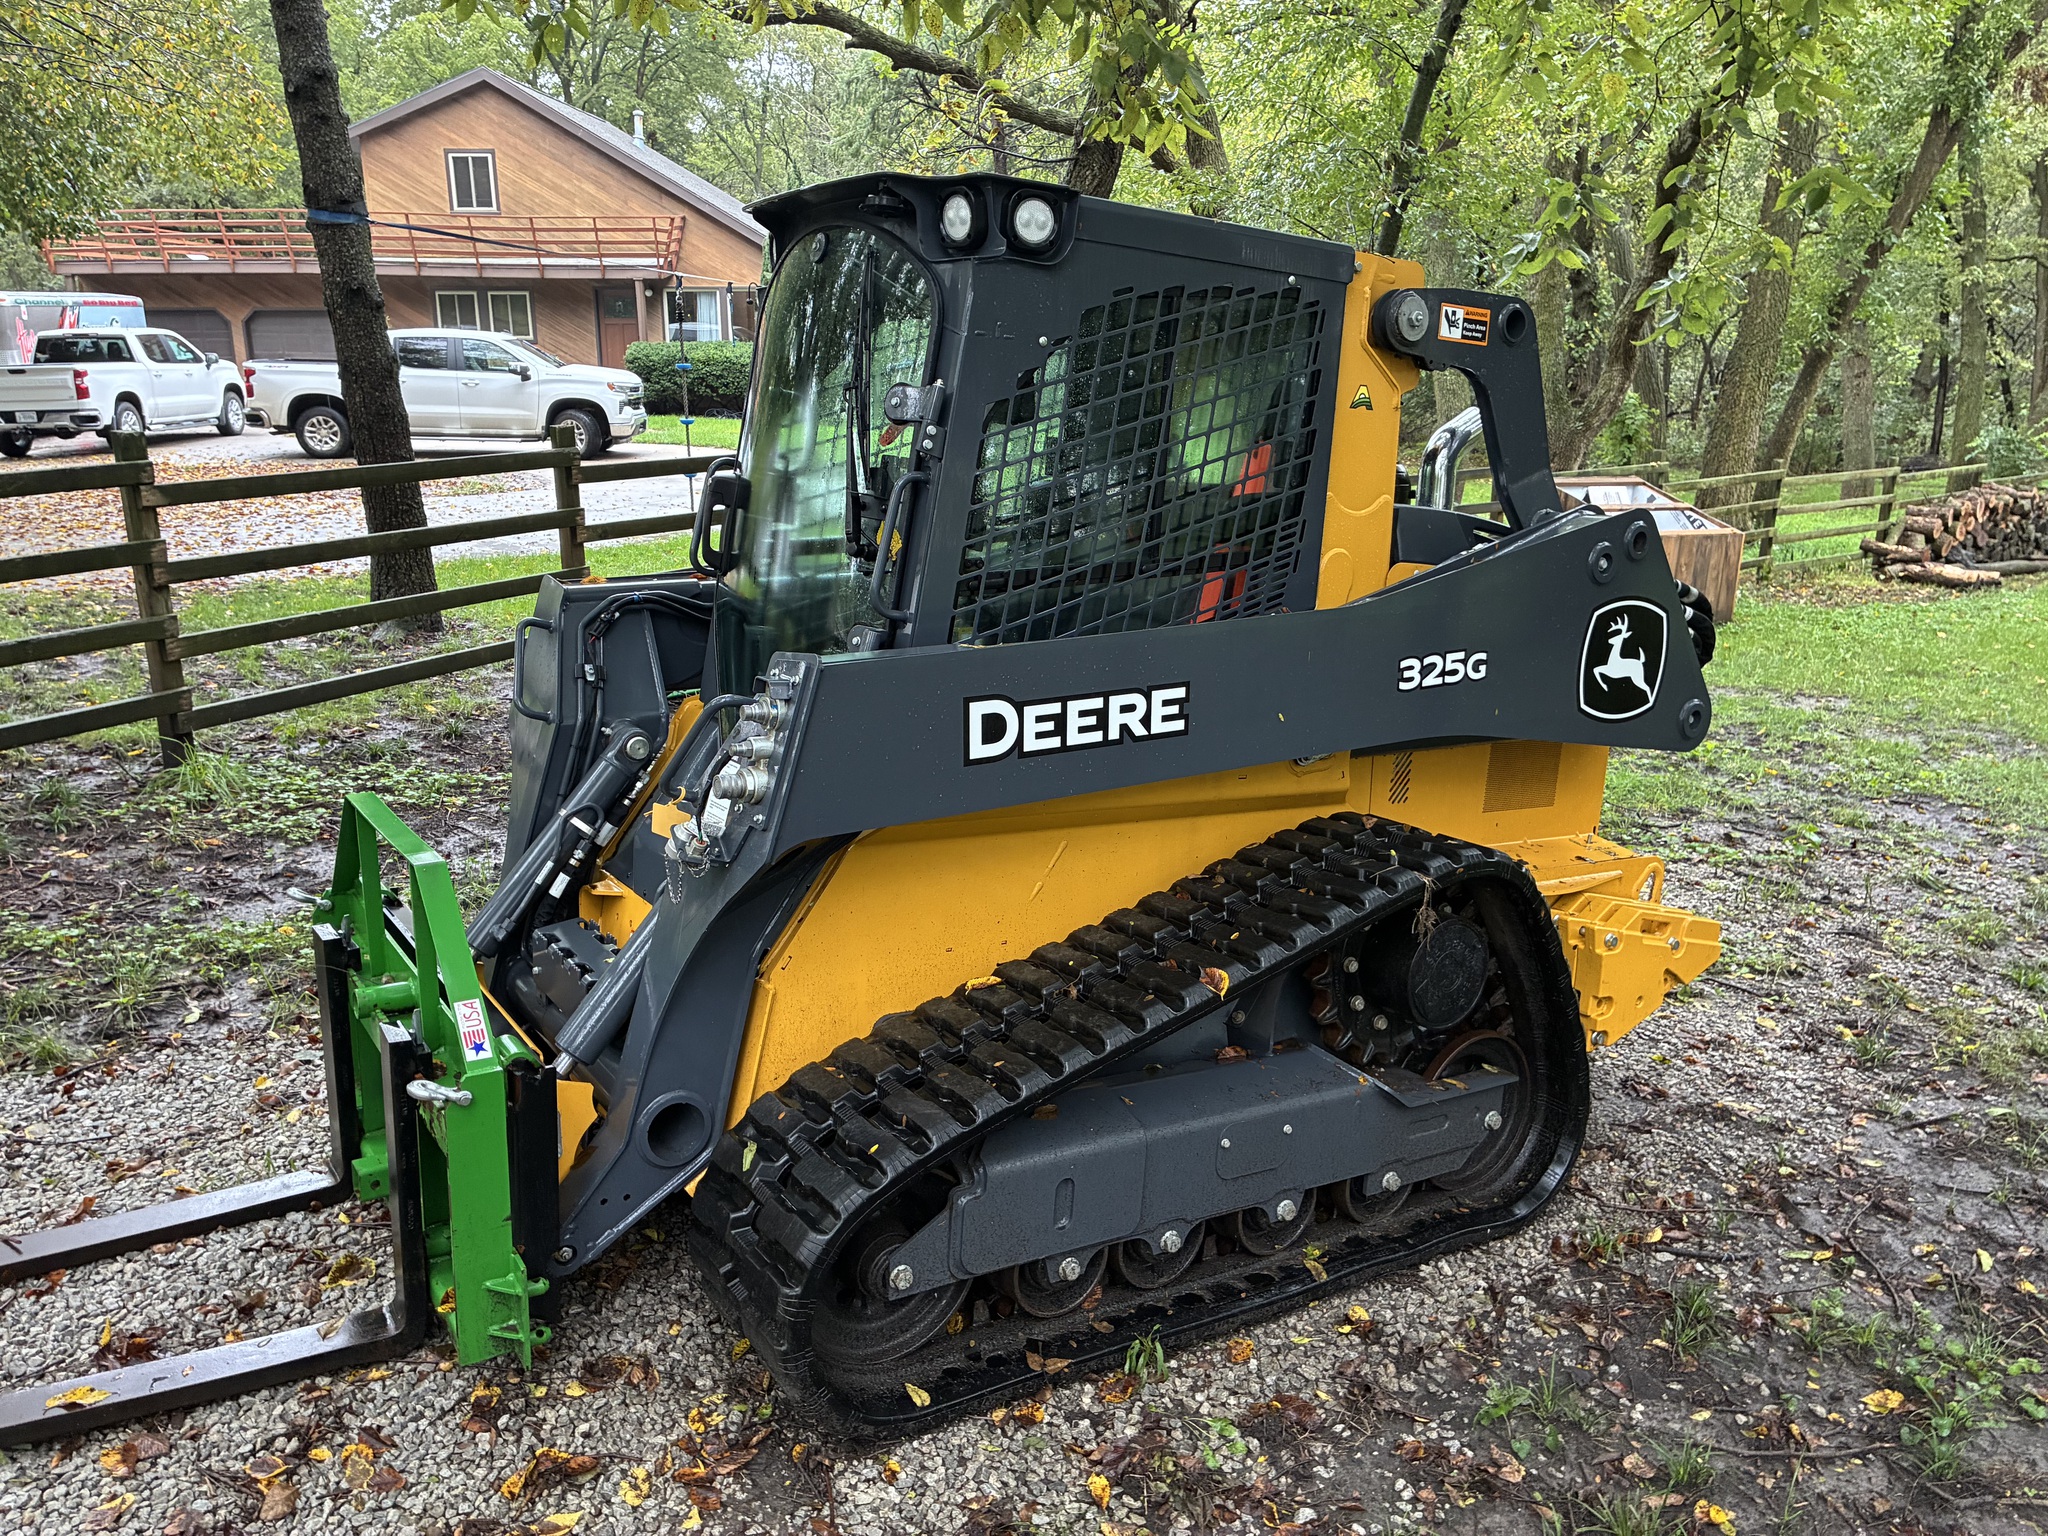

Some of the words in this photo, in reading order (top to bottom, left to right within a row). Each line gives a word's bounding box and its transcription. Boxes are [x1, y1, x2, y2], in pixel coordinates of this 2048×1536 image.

[1398, 651, 1488, 690] 325G
[968, 686, 1187, 760] DEERE
[462, 1001, 482, 1028] USA
